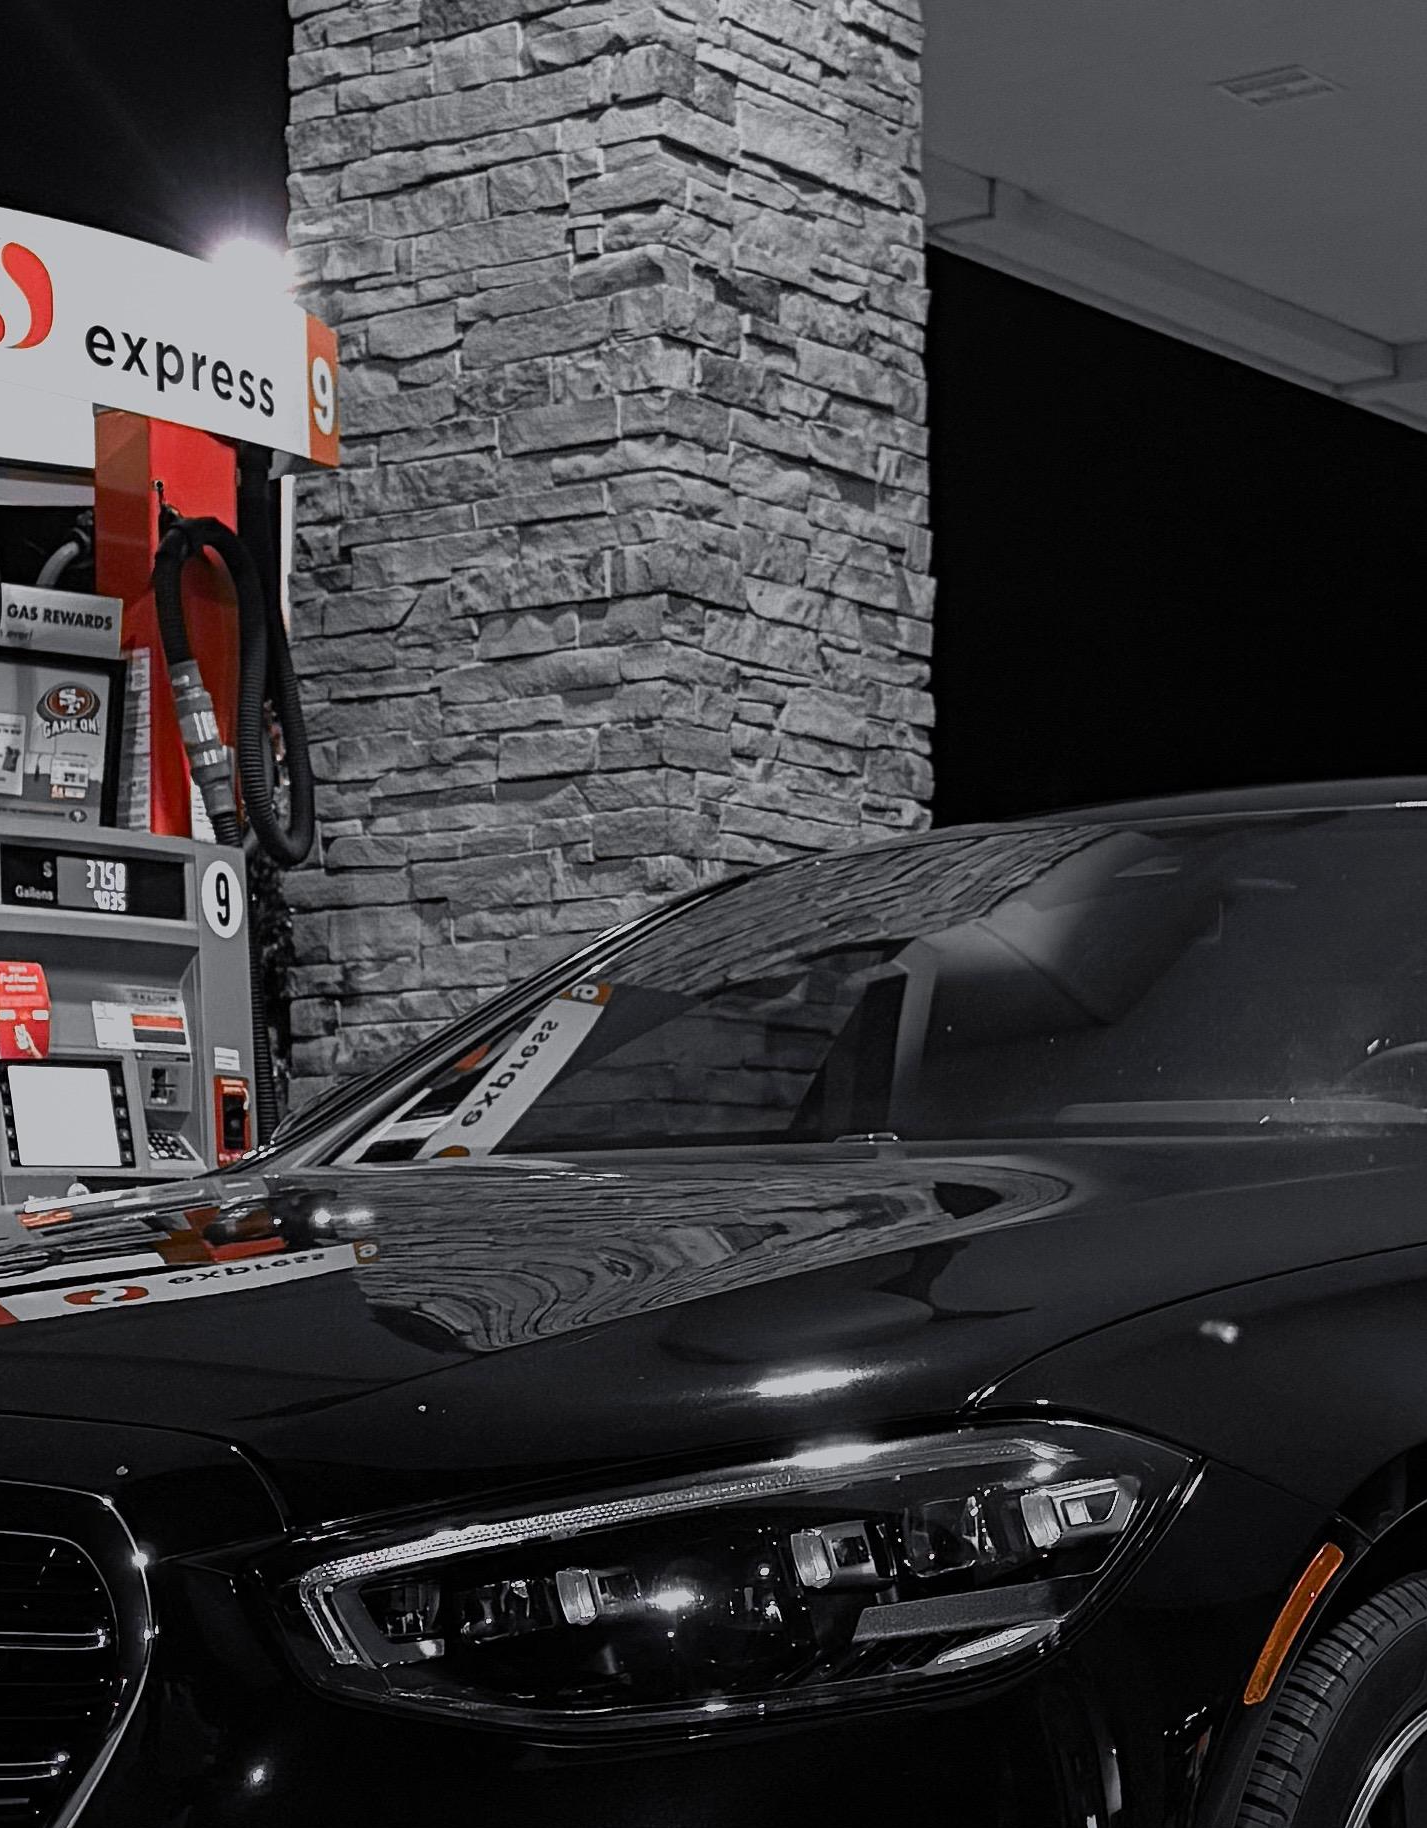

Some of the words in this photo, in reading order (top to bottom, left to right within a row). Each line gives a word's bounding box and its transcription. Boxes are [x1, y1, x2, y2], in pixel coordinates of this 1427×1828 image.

[84, 324, 275, 418] express
[310, 355, 336, 437] 9
[7, 603, 38, 621] GAS
[43, 608, 113, 631] REWARDS
[43, 719, 78, 738] GAME
[14, 884, 54, 901] Gallons
[215, 871, 230, 927] 9
